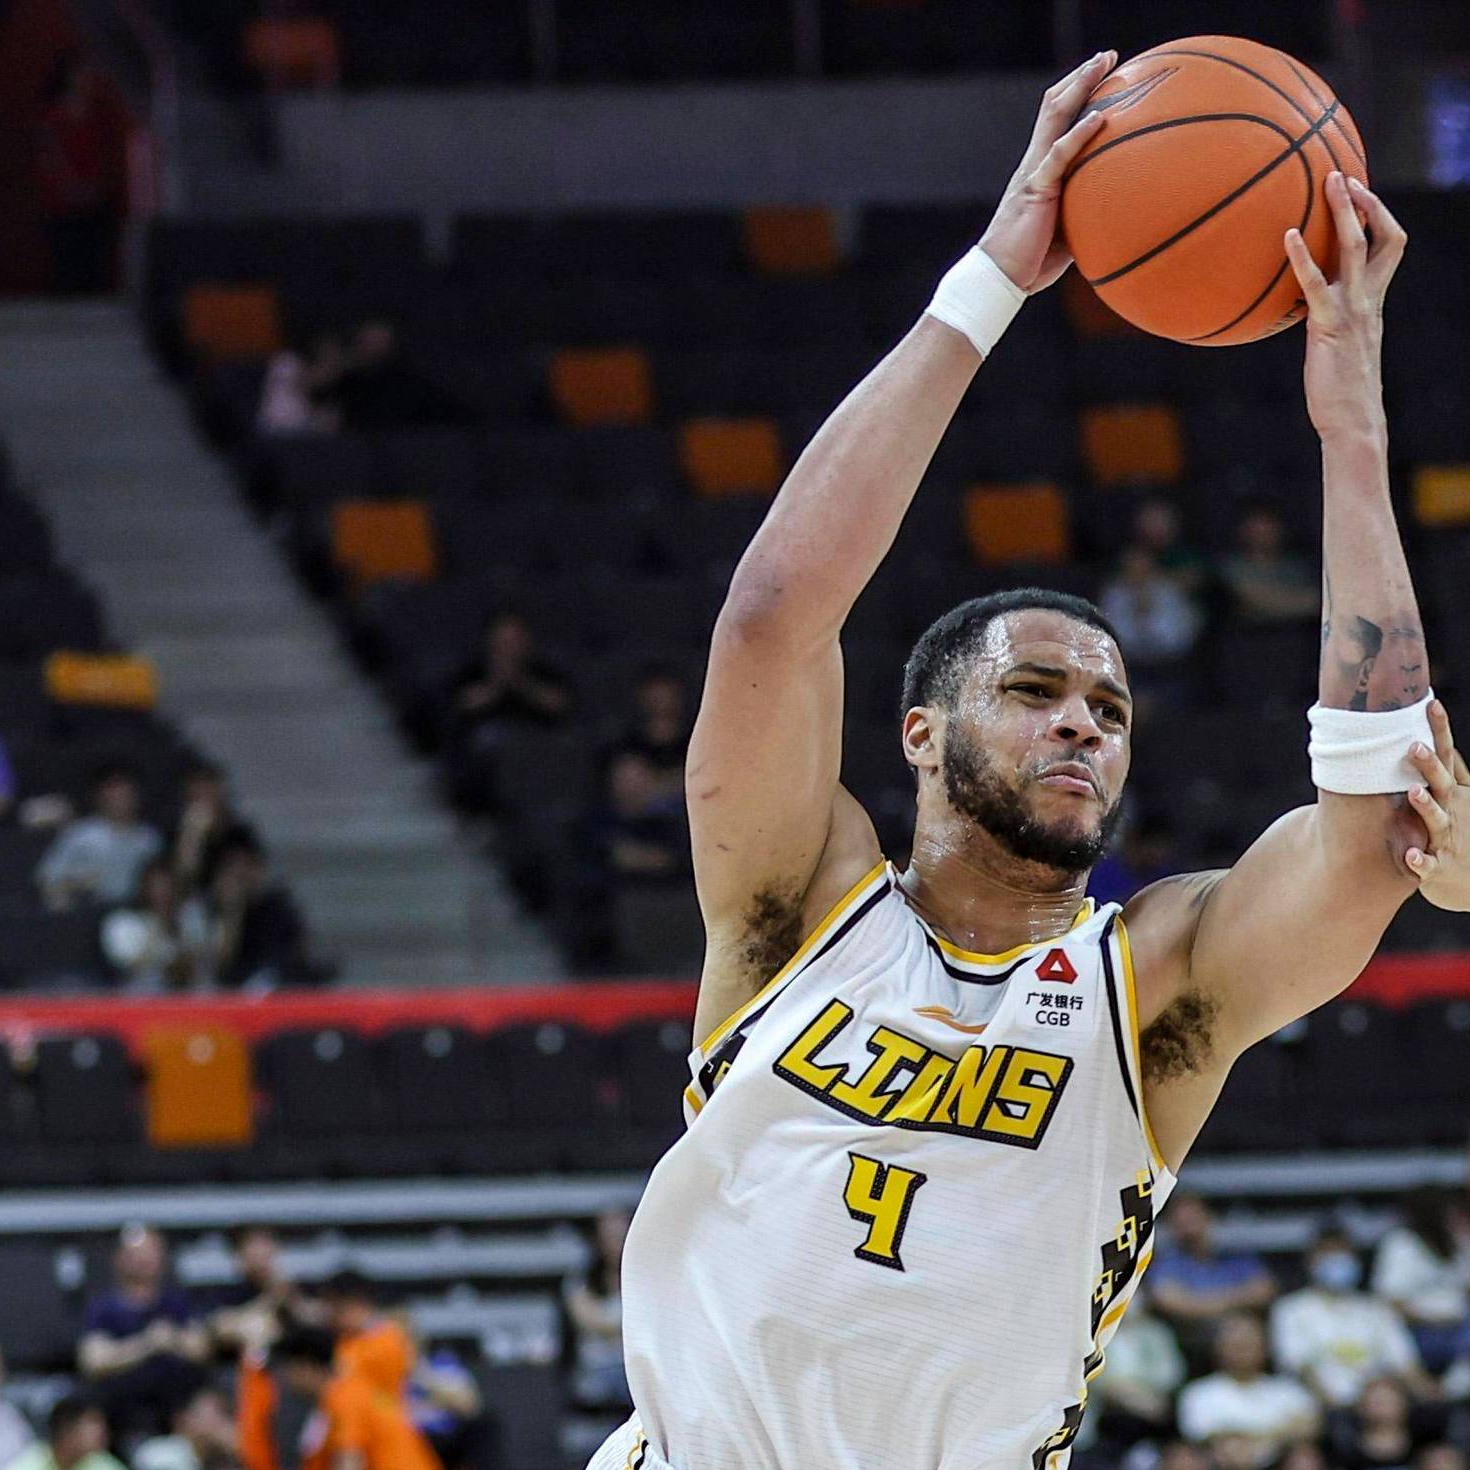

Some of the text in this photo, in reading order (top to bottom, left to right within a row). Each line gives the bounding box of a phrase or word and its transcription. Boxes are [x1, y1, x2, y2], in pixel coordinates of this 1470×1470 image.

[1026, 992, 1083, 1010] 广发银行
[1036, 1010, 1070, 1027] CGB
[842, 1151, 927, 1272] 4
